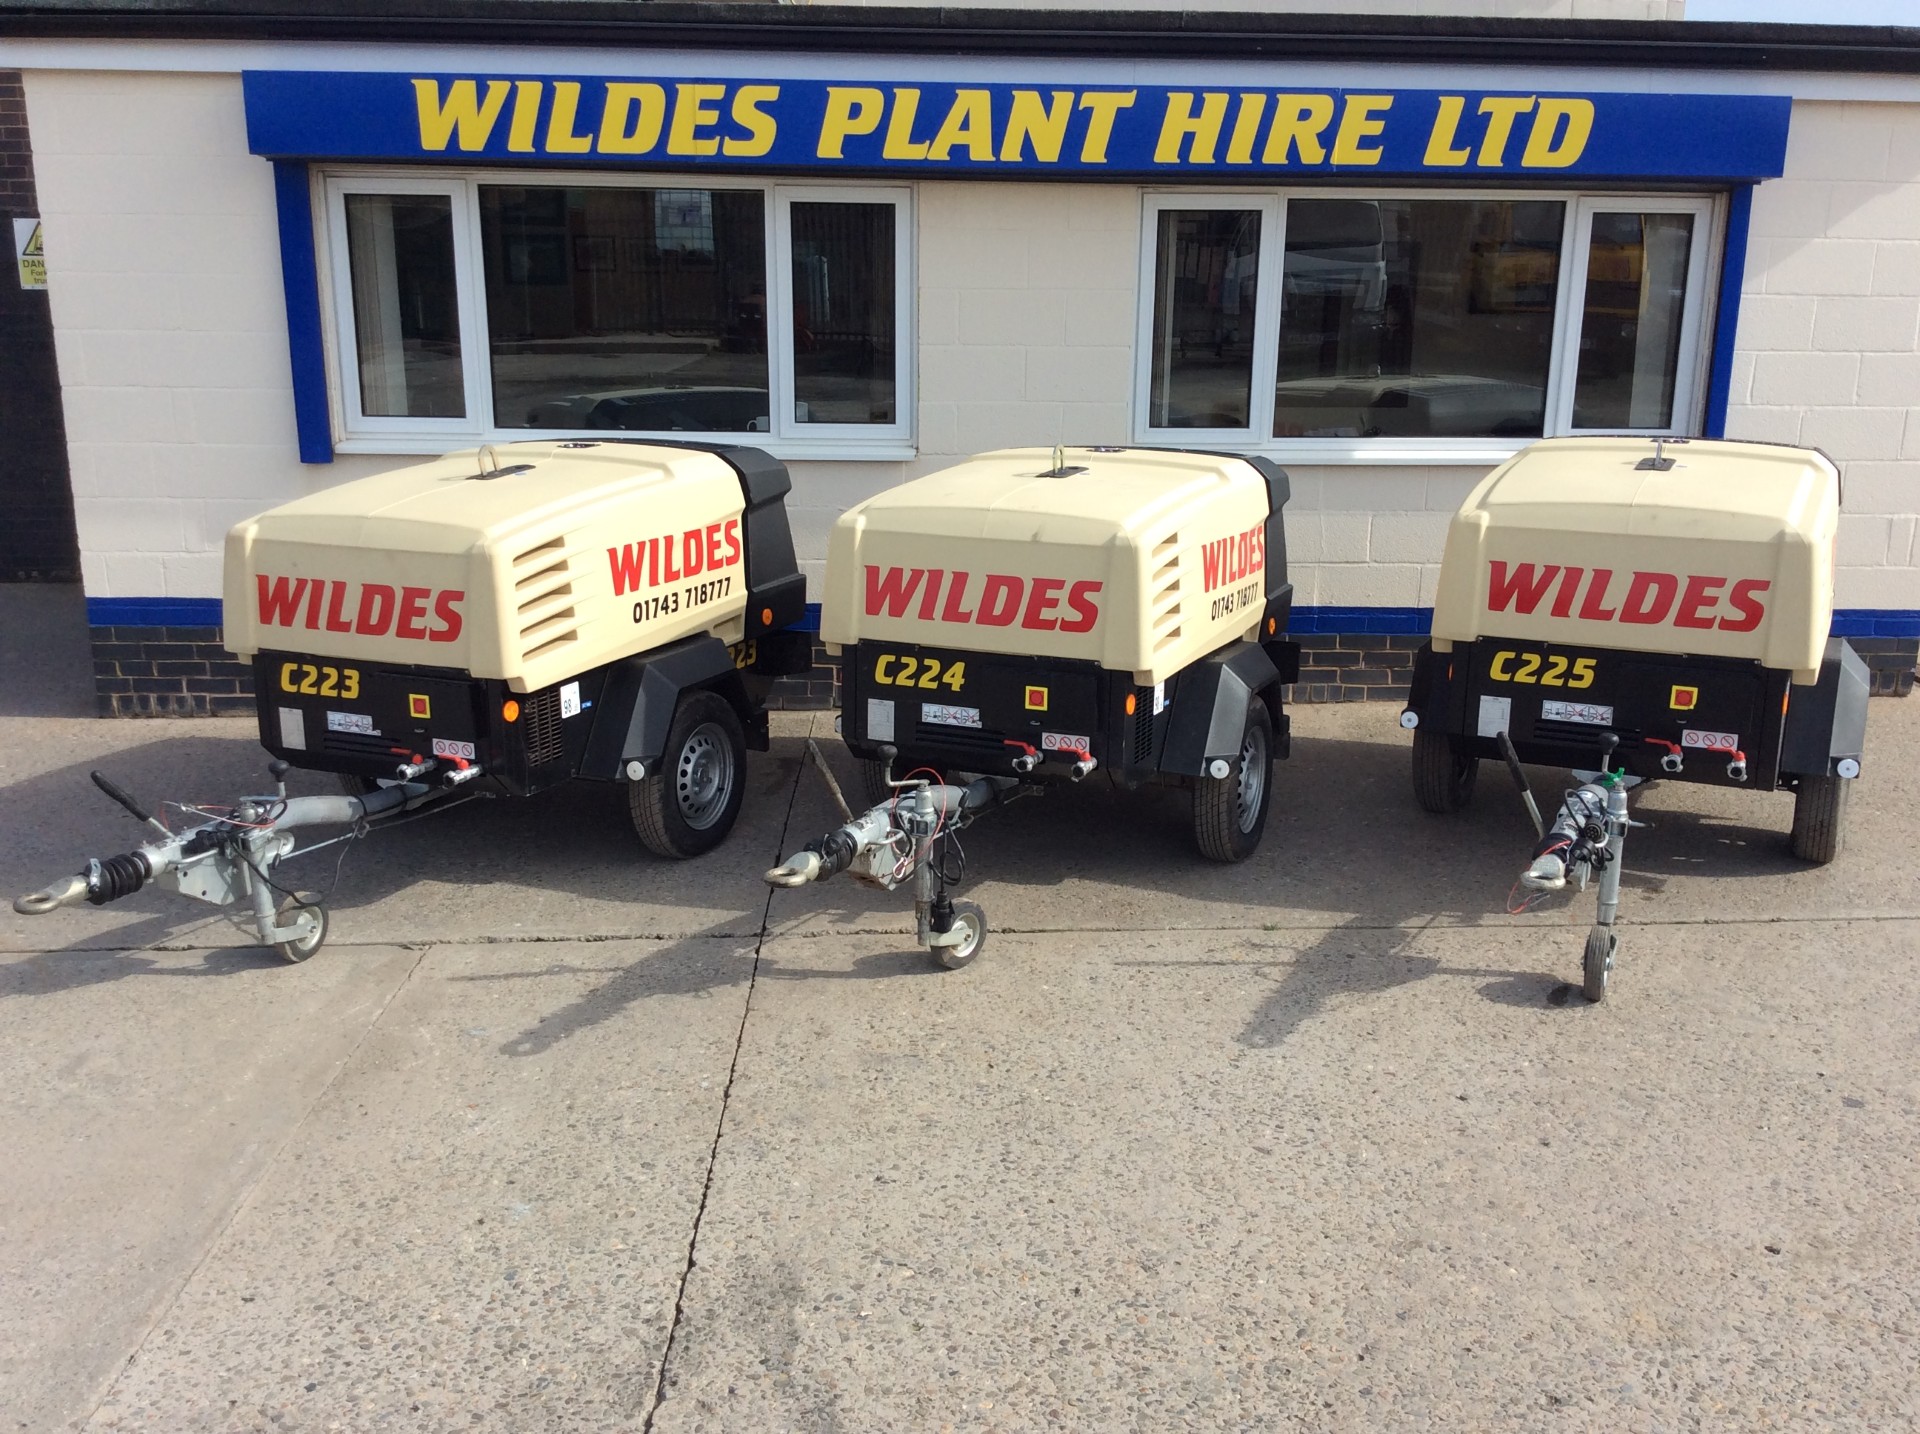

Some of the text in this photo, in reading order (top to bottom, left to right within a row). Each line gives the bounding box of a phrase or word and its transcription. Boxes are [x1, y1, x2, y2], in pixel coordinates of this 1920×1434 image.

[413, 79, 1595, 168] WILDES PLANT HIRE LTD
[606, 519, 741, 596] WILDES
[1201, 525, 1264, 593] WILDES
[256, 574, 465, 643] WILDES
[633, 576, 731, 624] 01743 718777
[865, 565, 1103, 633] WILDES
[1211, 581, 1258, 621] 01743 718777
[1487, 560, 1771, 633] WILDES
[280, 662, 360, 699] C223
[874, 654, 966, 692] C224
[1489, 651, 1597, 689] C225
